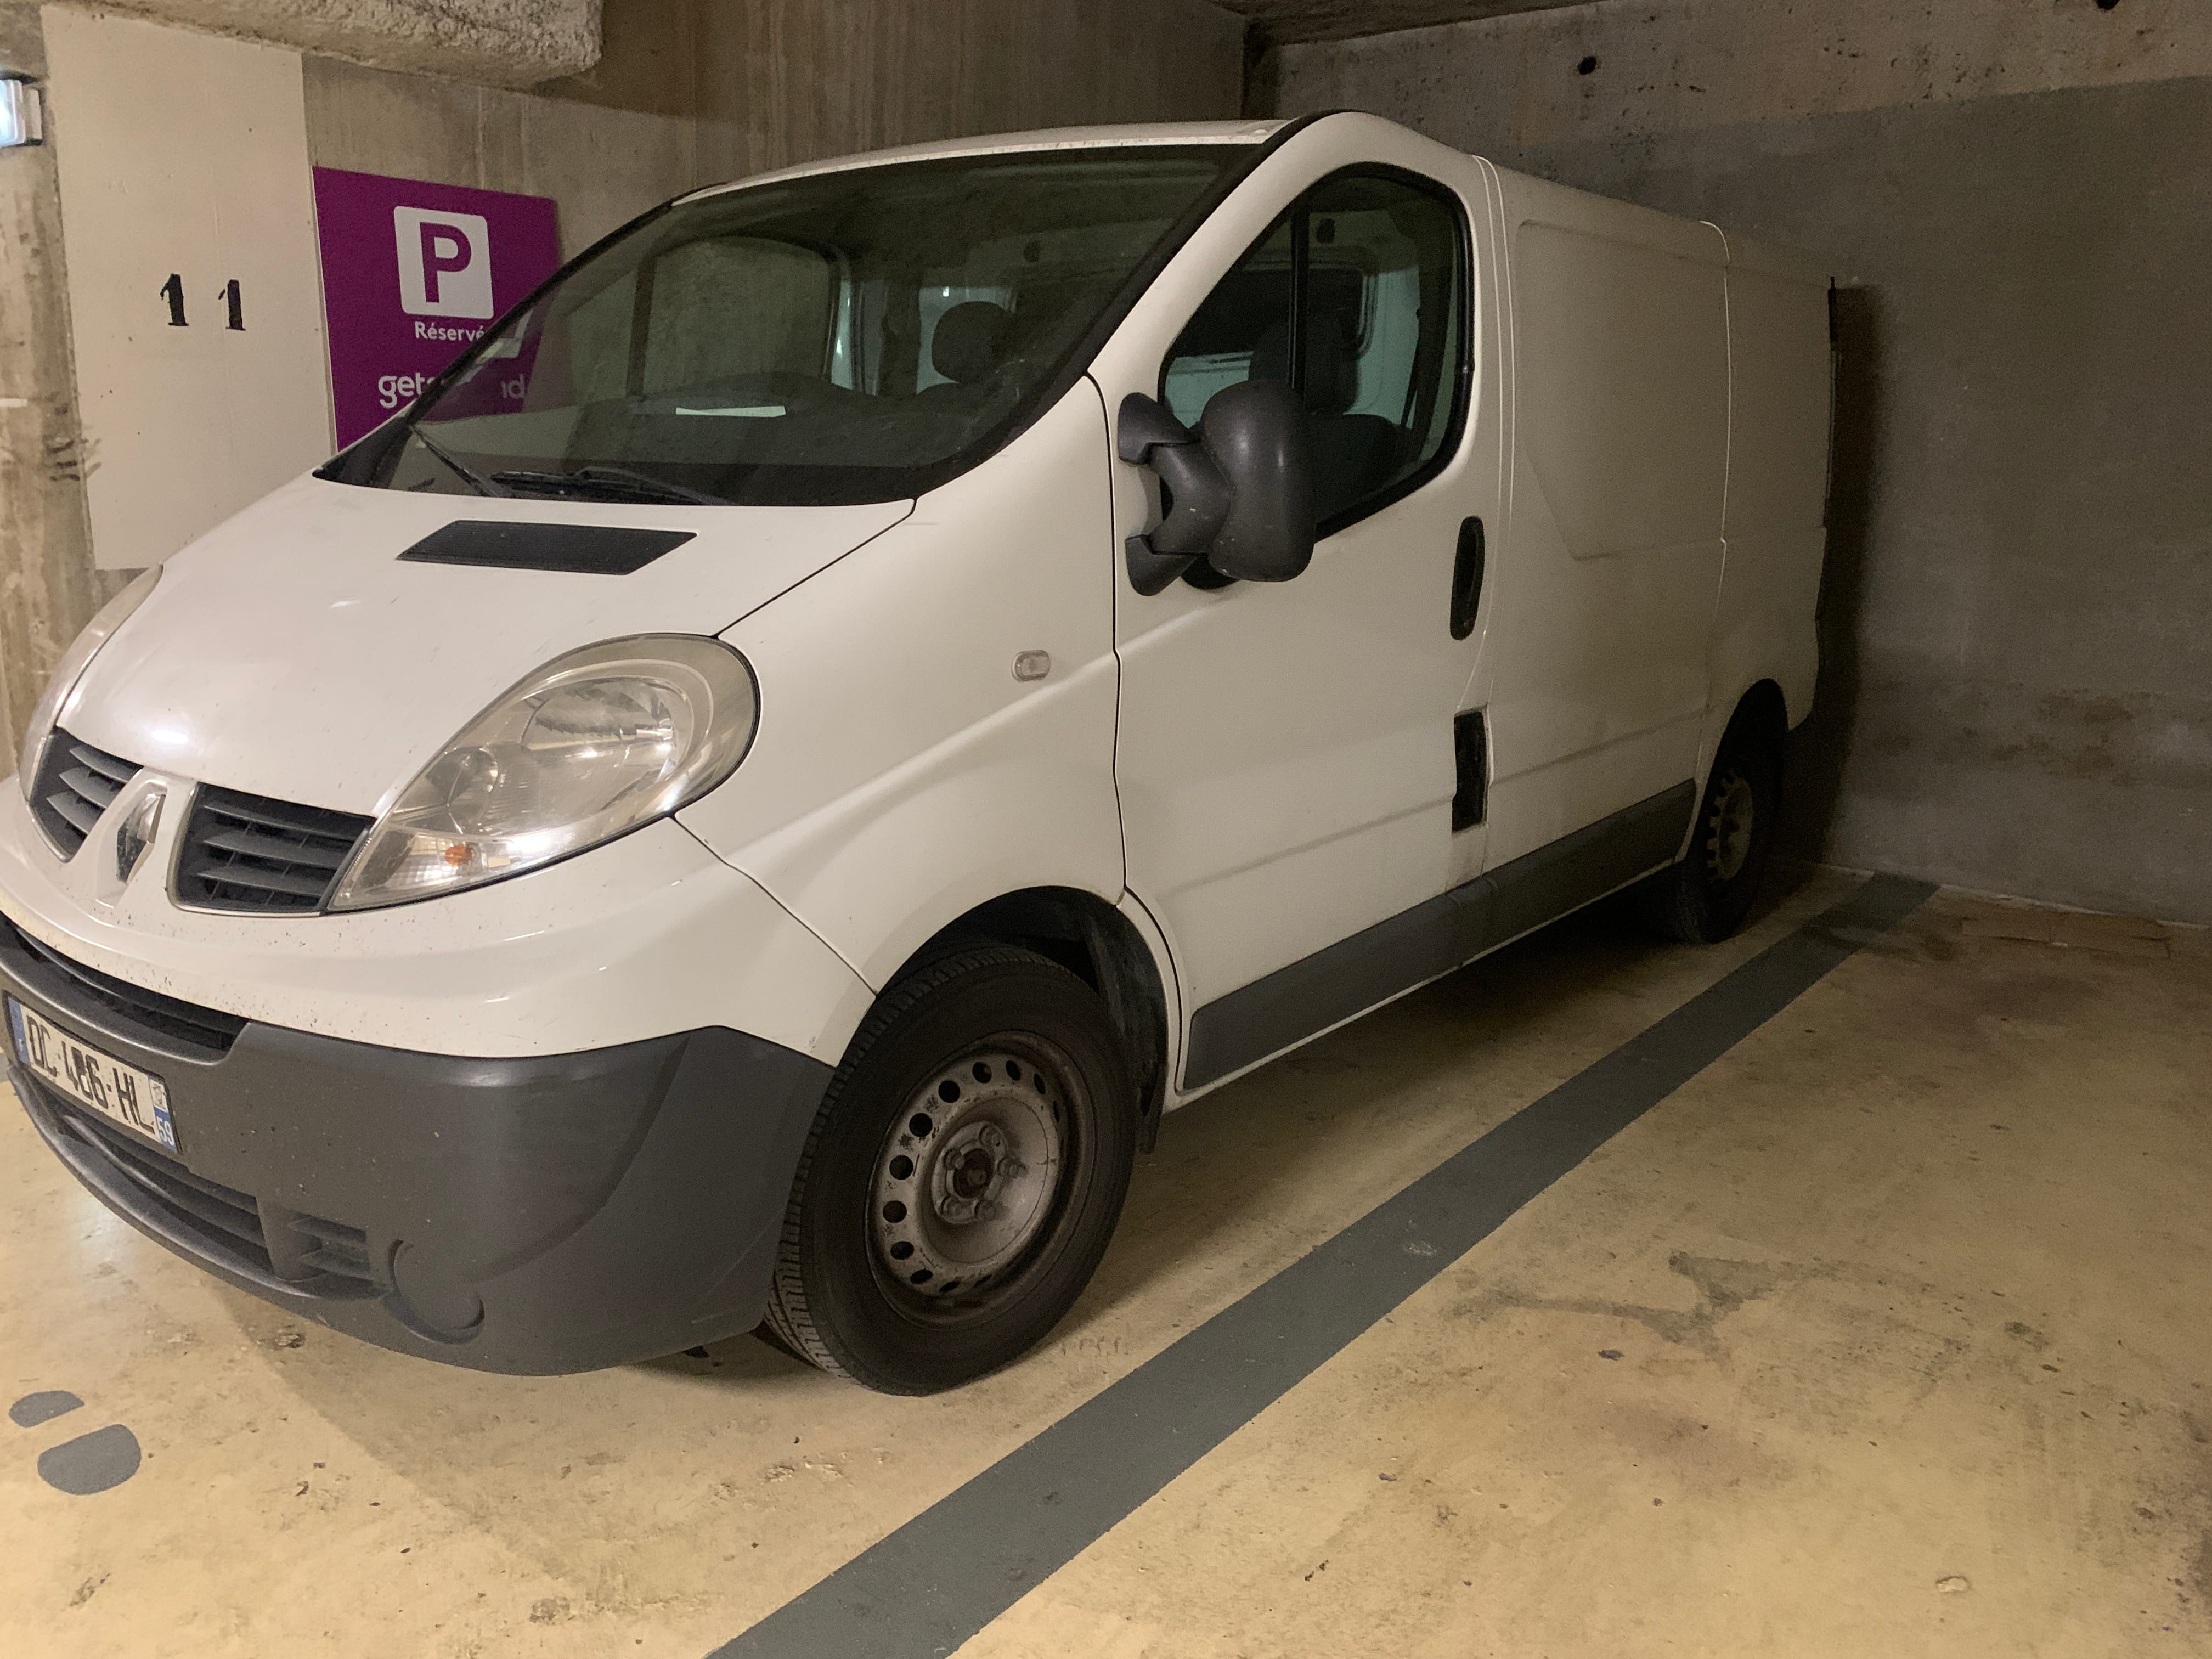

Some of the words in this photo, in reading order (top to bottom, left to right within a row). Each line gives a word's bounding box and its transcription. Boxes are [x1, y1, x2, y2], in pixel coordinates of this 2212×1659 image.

[420, 222, 472, 303] P
[415, 321, 485, 341] Réservé
[156, 1116, 175, 1146] 59
